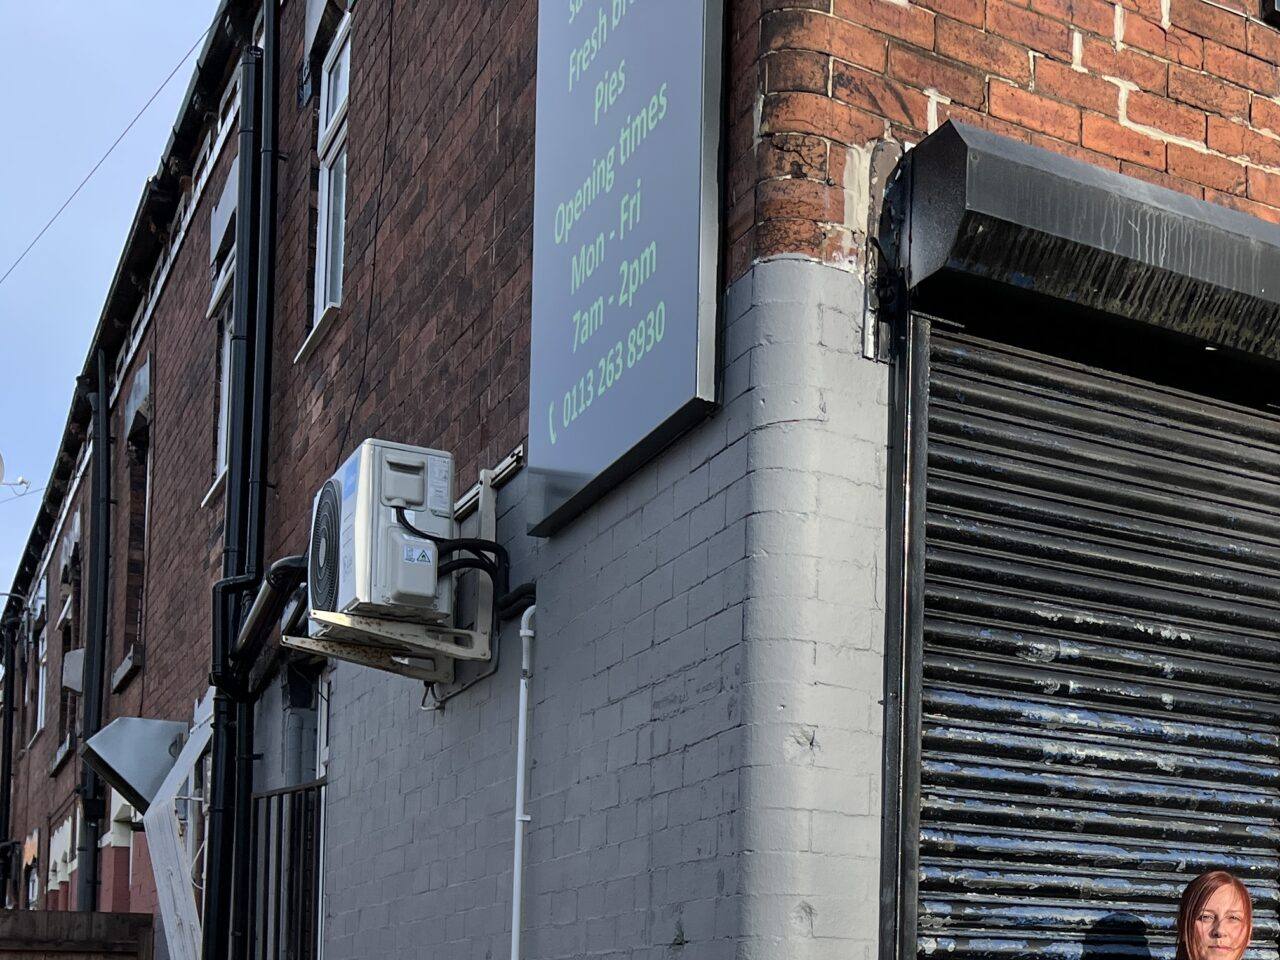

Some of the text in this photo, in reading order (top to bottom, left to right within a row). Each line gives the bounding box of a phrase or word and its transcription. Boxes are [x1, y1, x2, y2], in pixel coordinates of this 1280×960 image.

[569, 7, 607, 93] Fresh
[594, 59, 626, 126] Pies
[555, 146, 615, 244] Opening
[620, 82, 668, 166] times
[571, 232, 604, 295] Mon
[620, 178, 641, 240] Fri
[572, 296, 604, 354] 7am
[618, 240, 657, 308] 2pm
[563, 301, 666, 428] 0113 263 8930
